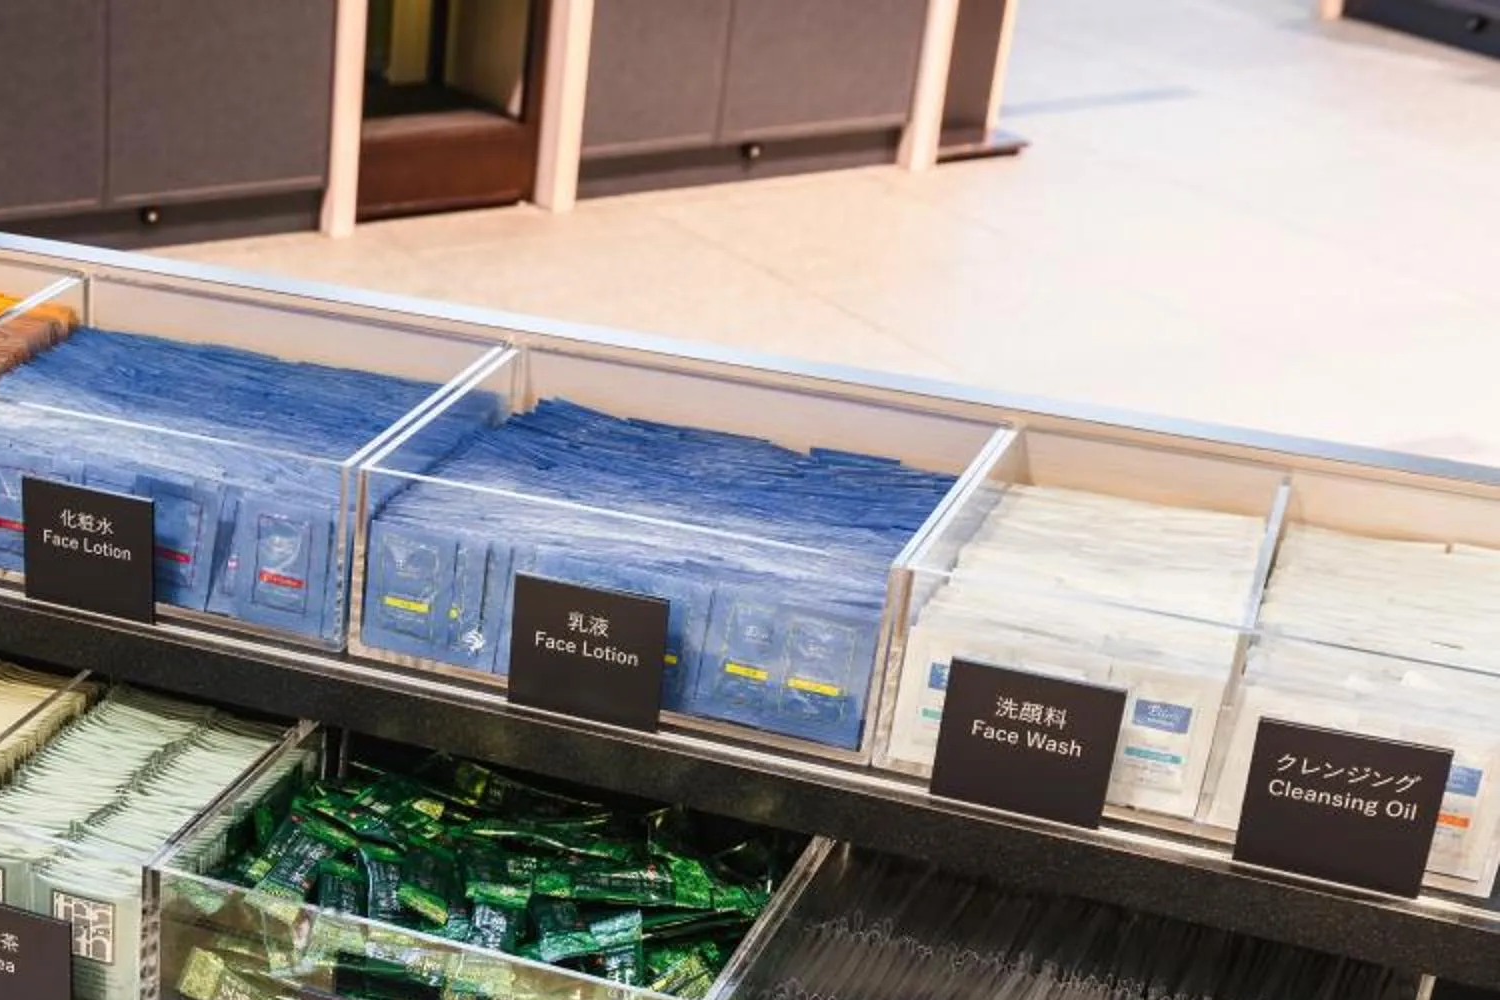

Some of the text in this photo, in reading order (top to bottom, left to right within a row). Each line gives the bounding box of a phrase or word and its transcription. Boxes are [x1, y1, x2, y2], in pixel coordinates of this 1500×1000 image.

[60, 508, 114, 535] 化粧水
[43, 529, 131, 561] Face Lotion
[568, 611, 608, 638] 乳液
[535, 630, 639, 667] Face Lotion
[995, 696, 1067, 730] 洗顔料
[971, 719, 1082, 757] Face Wash
[1277, 754, 1422, 793] クレンジング
[1268, 779, 1417, 821] Cleansing Oil
